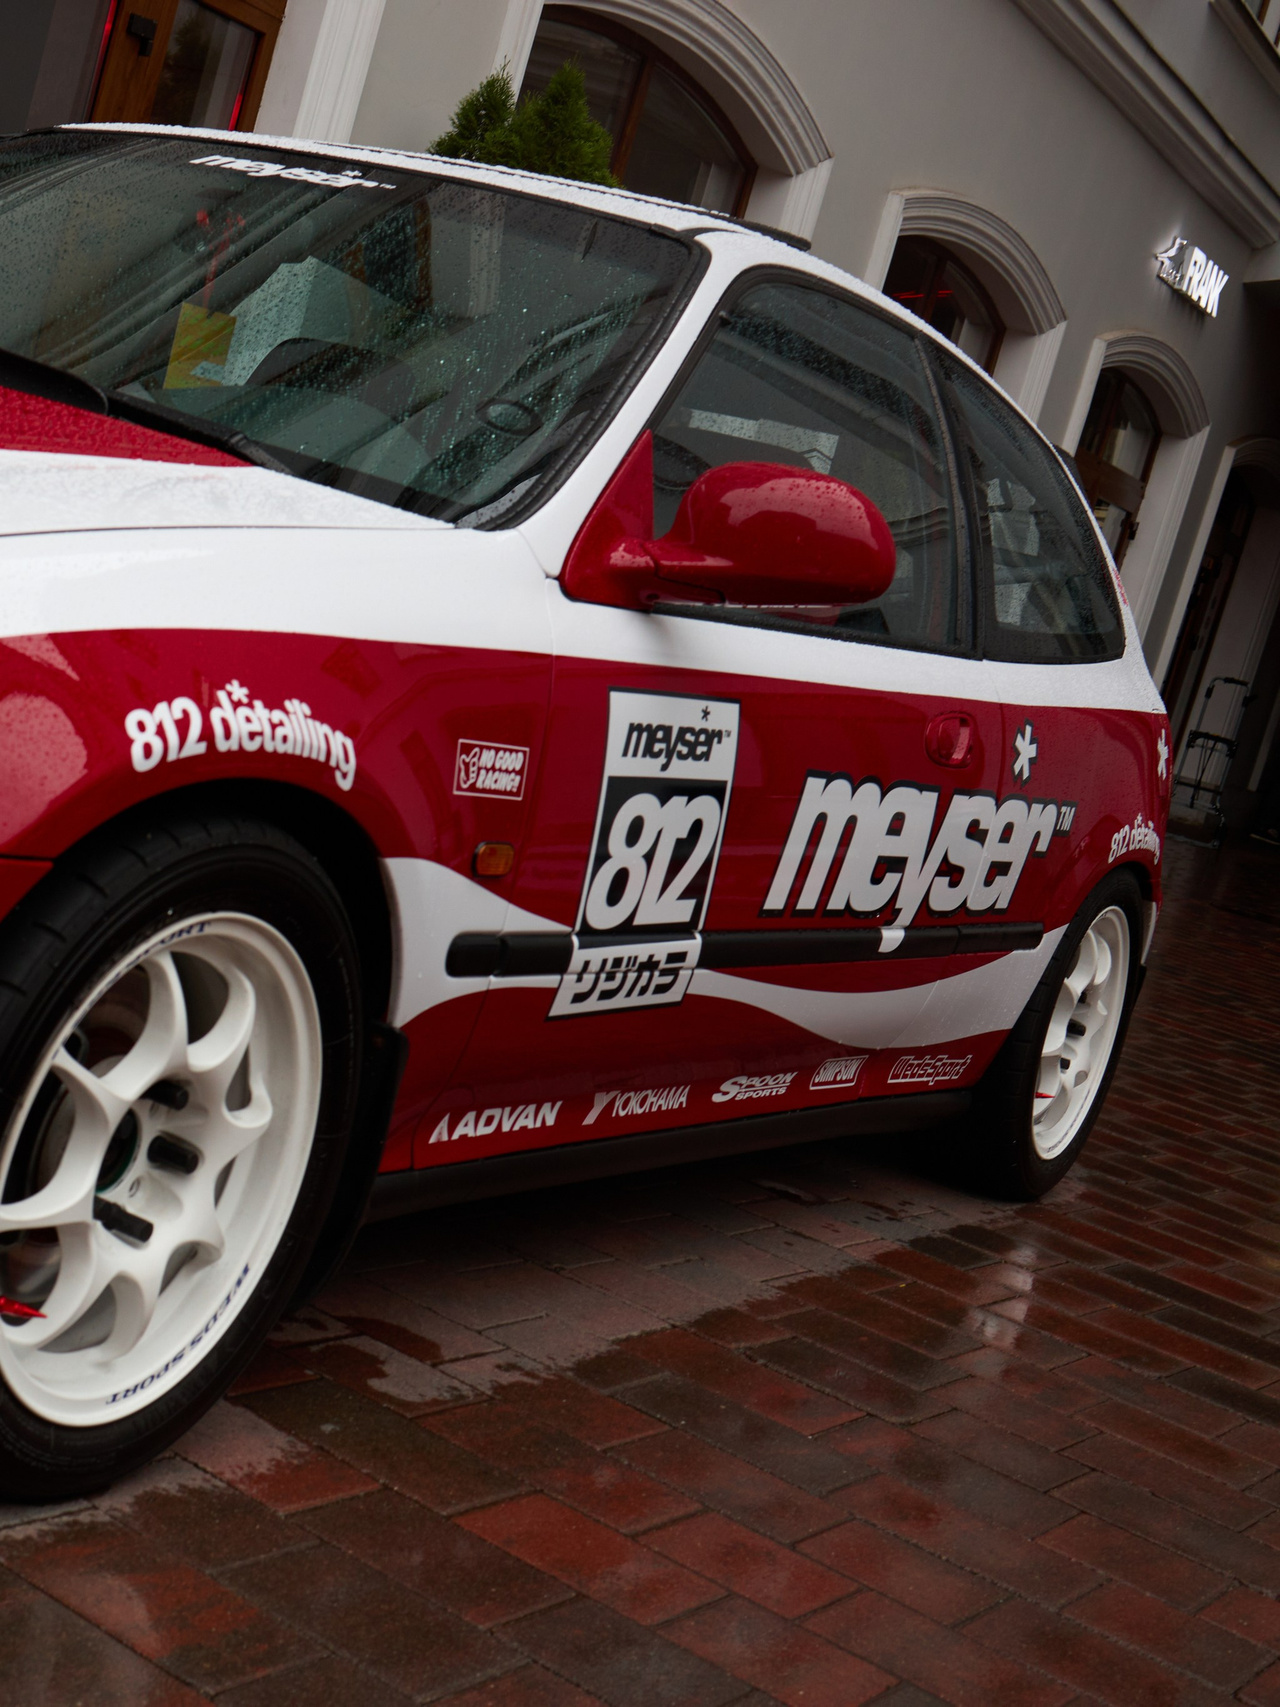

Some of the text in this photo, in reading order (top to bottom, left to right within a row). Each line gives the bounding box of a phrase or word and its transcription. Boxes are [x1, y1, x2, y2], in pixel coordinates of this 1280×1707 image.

[1182, 246, 1230, 318] FRANK
[124, 680, 357, 792] 812 detailing
[479, 748, 524, 771] NO GOOD
[585, 793, 721, 931] 812
[1108, 824, 1130, 864] 812
[569, 950, 688, 1004] リジカラ
[711, 1071, 799, 1103] SPOON
[814, 1058, 865, 1084] SIMPSON
[611, 1085, 691, 1118] YOKOHAMA
[734, 1086, 788, 1101] SPORTS
[450, 1101, 563, 1141] ADVAN
